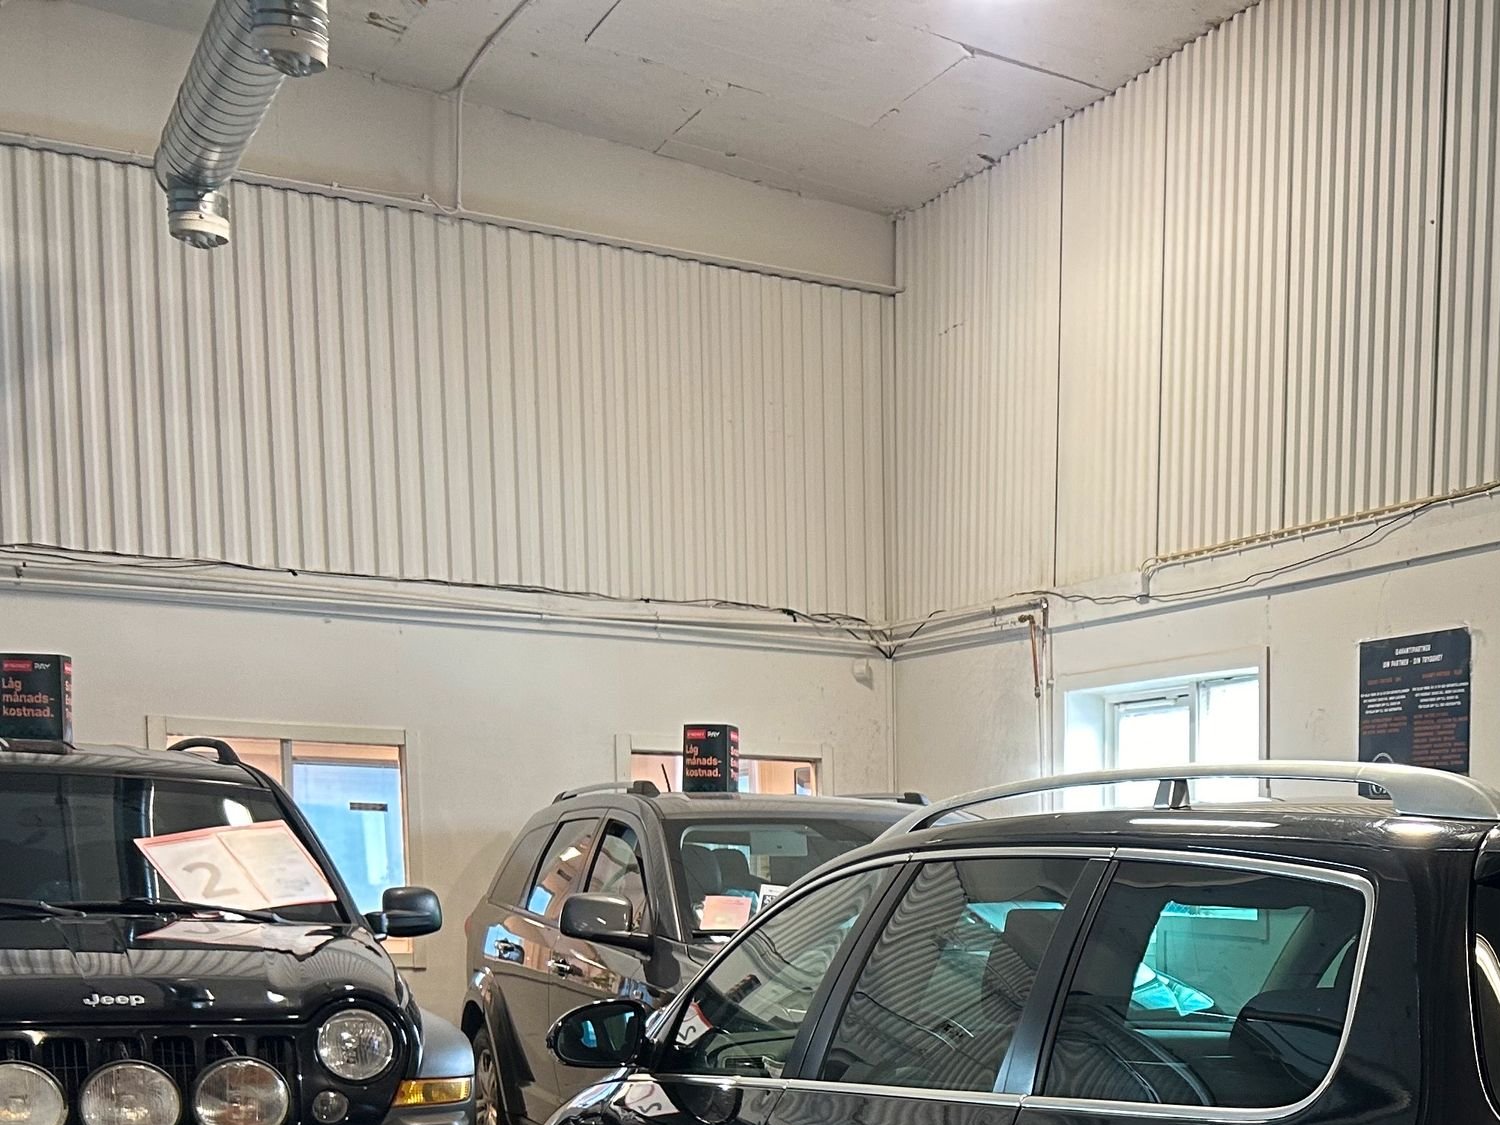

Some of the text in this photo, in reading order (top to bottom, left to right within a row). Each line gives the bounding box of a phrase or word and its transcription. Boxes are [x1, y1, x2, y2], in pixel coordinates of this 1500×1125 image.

[2, 676, 22, 691] Låg
[2, 691, 55, 704] månads-
[2, 705, 55, 718] kostnad.
[685, 744, 699, 756] Låg
[685, 755, 723, 766] månads-
[685, 767, 721, 777] kostnad.
[83, 993, 145, 1007] Jeep
